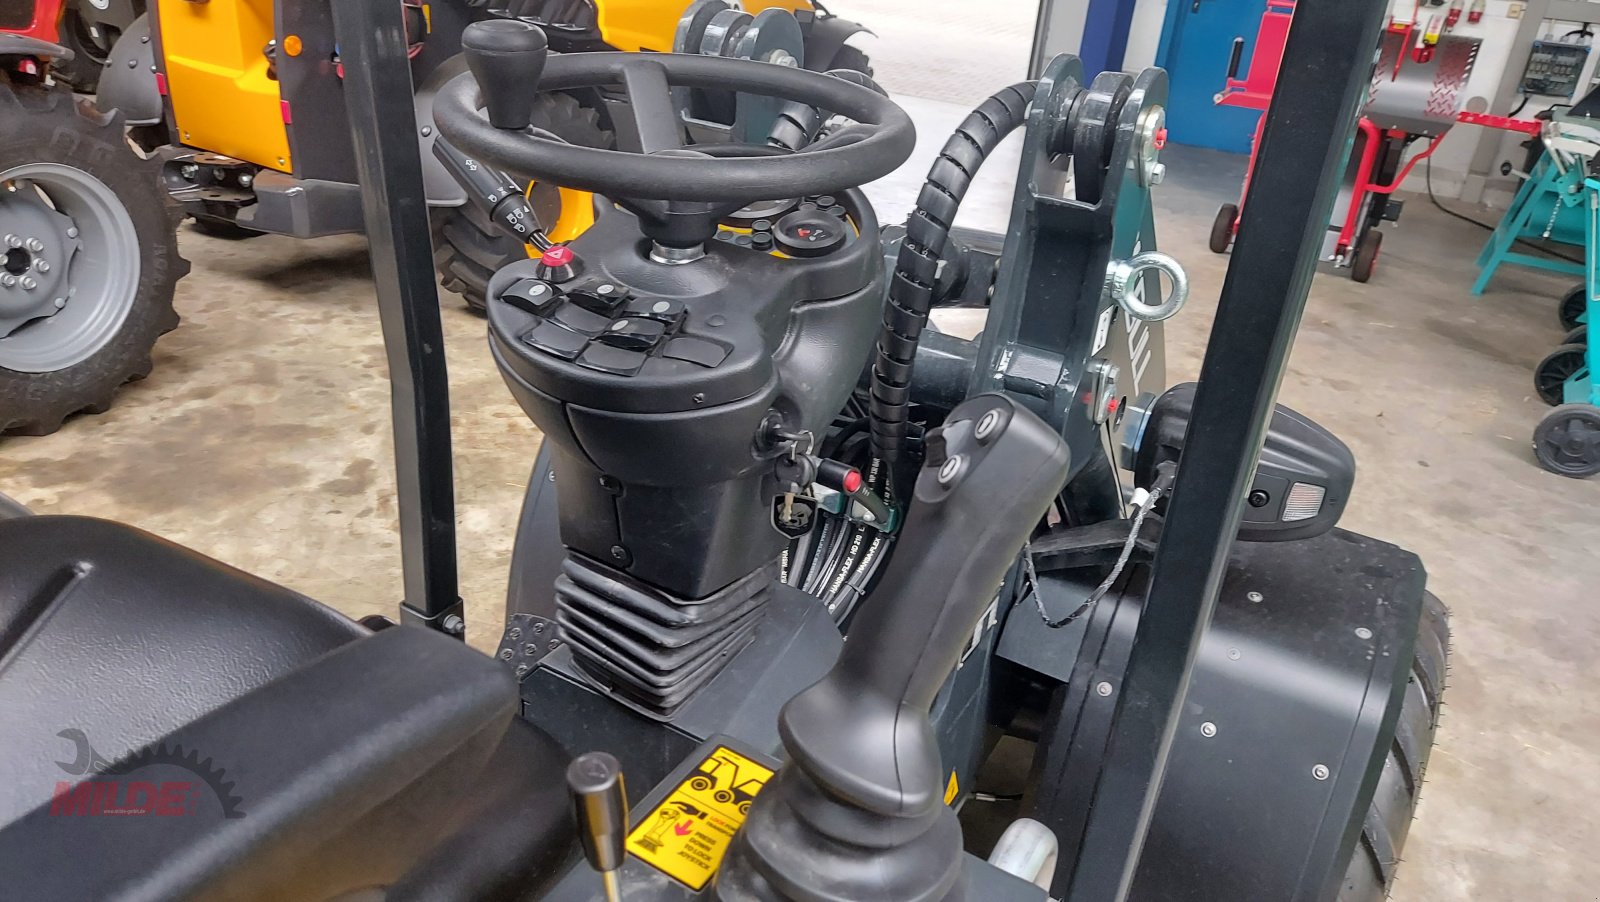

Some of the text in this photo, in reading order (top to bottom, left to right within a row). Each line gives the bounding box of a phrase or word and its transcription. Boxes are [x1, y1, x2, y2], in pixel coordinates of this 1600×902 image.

[850, 544, 859, 555] HD
[854, 534, 864, 546] 210
[856, 537, 881, 574] HANSA-FLEX
[830, 556, 854, 594] HANSA-FLEX
